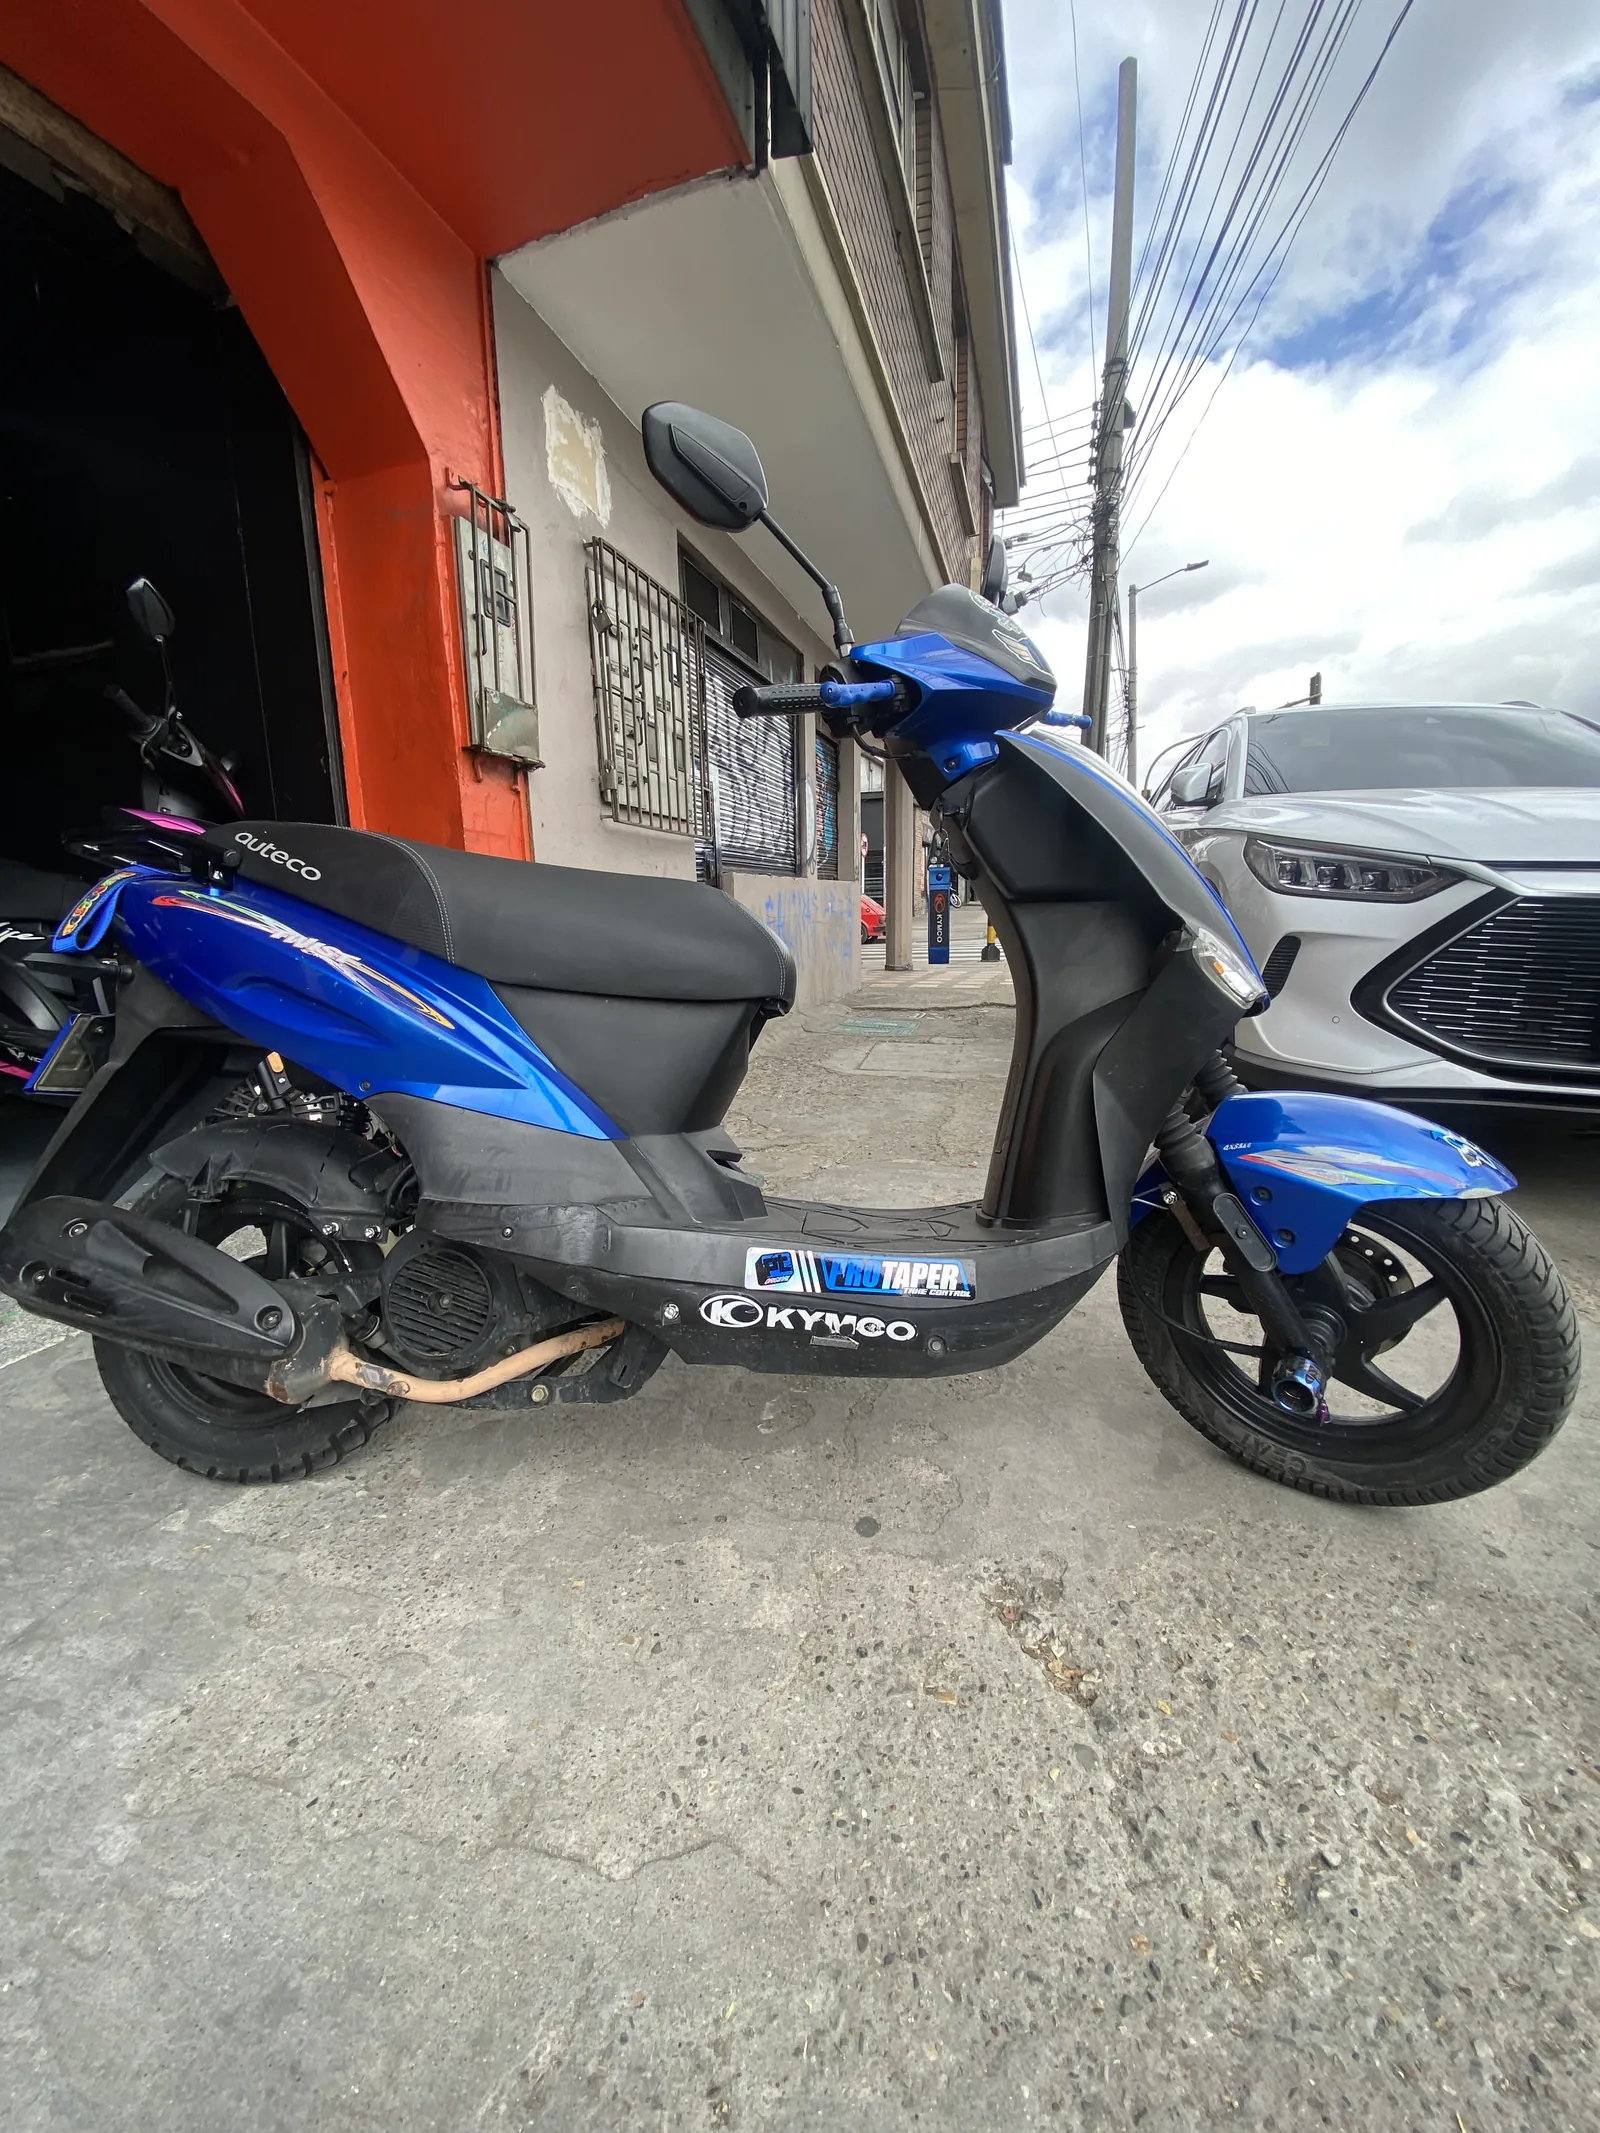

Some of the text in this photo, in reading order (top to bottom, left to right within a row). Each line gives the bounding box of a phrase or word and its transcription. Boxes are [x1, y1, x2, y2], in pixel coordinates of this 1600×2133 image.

[234, 832, 322, 881] auteco
[269, 927, 361, 964] TWIST
[828, 1257, 960, 1290] PROTAPER
[928, 1288, 972, 1298] CONTROL
[1237, 1432, 1307, 1477] CEAT
